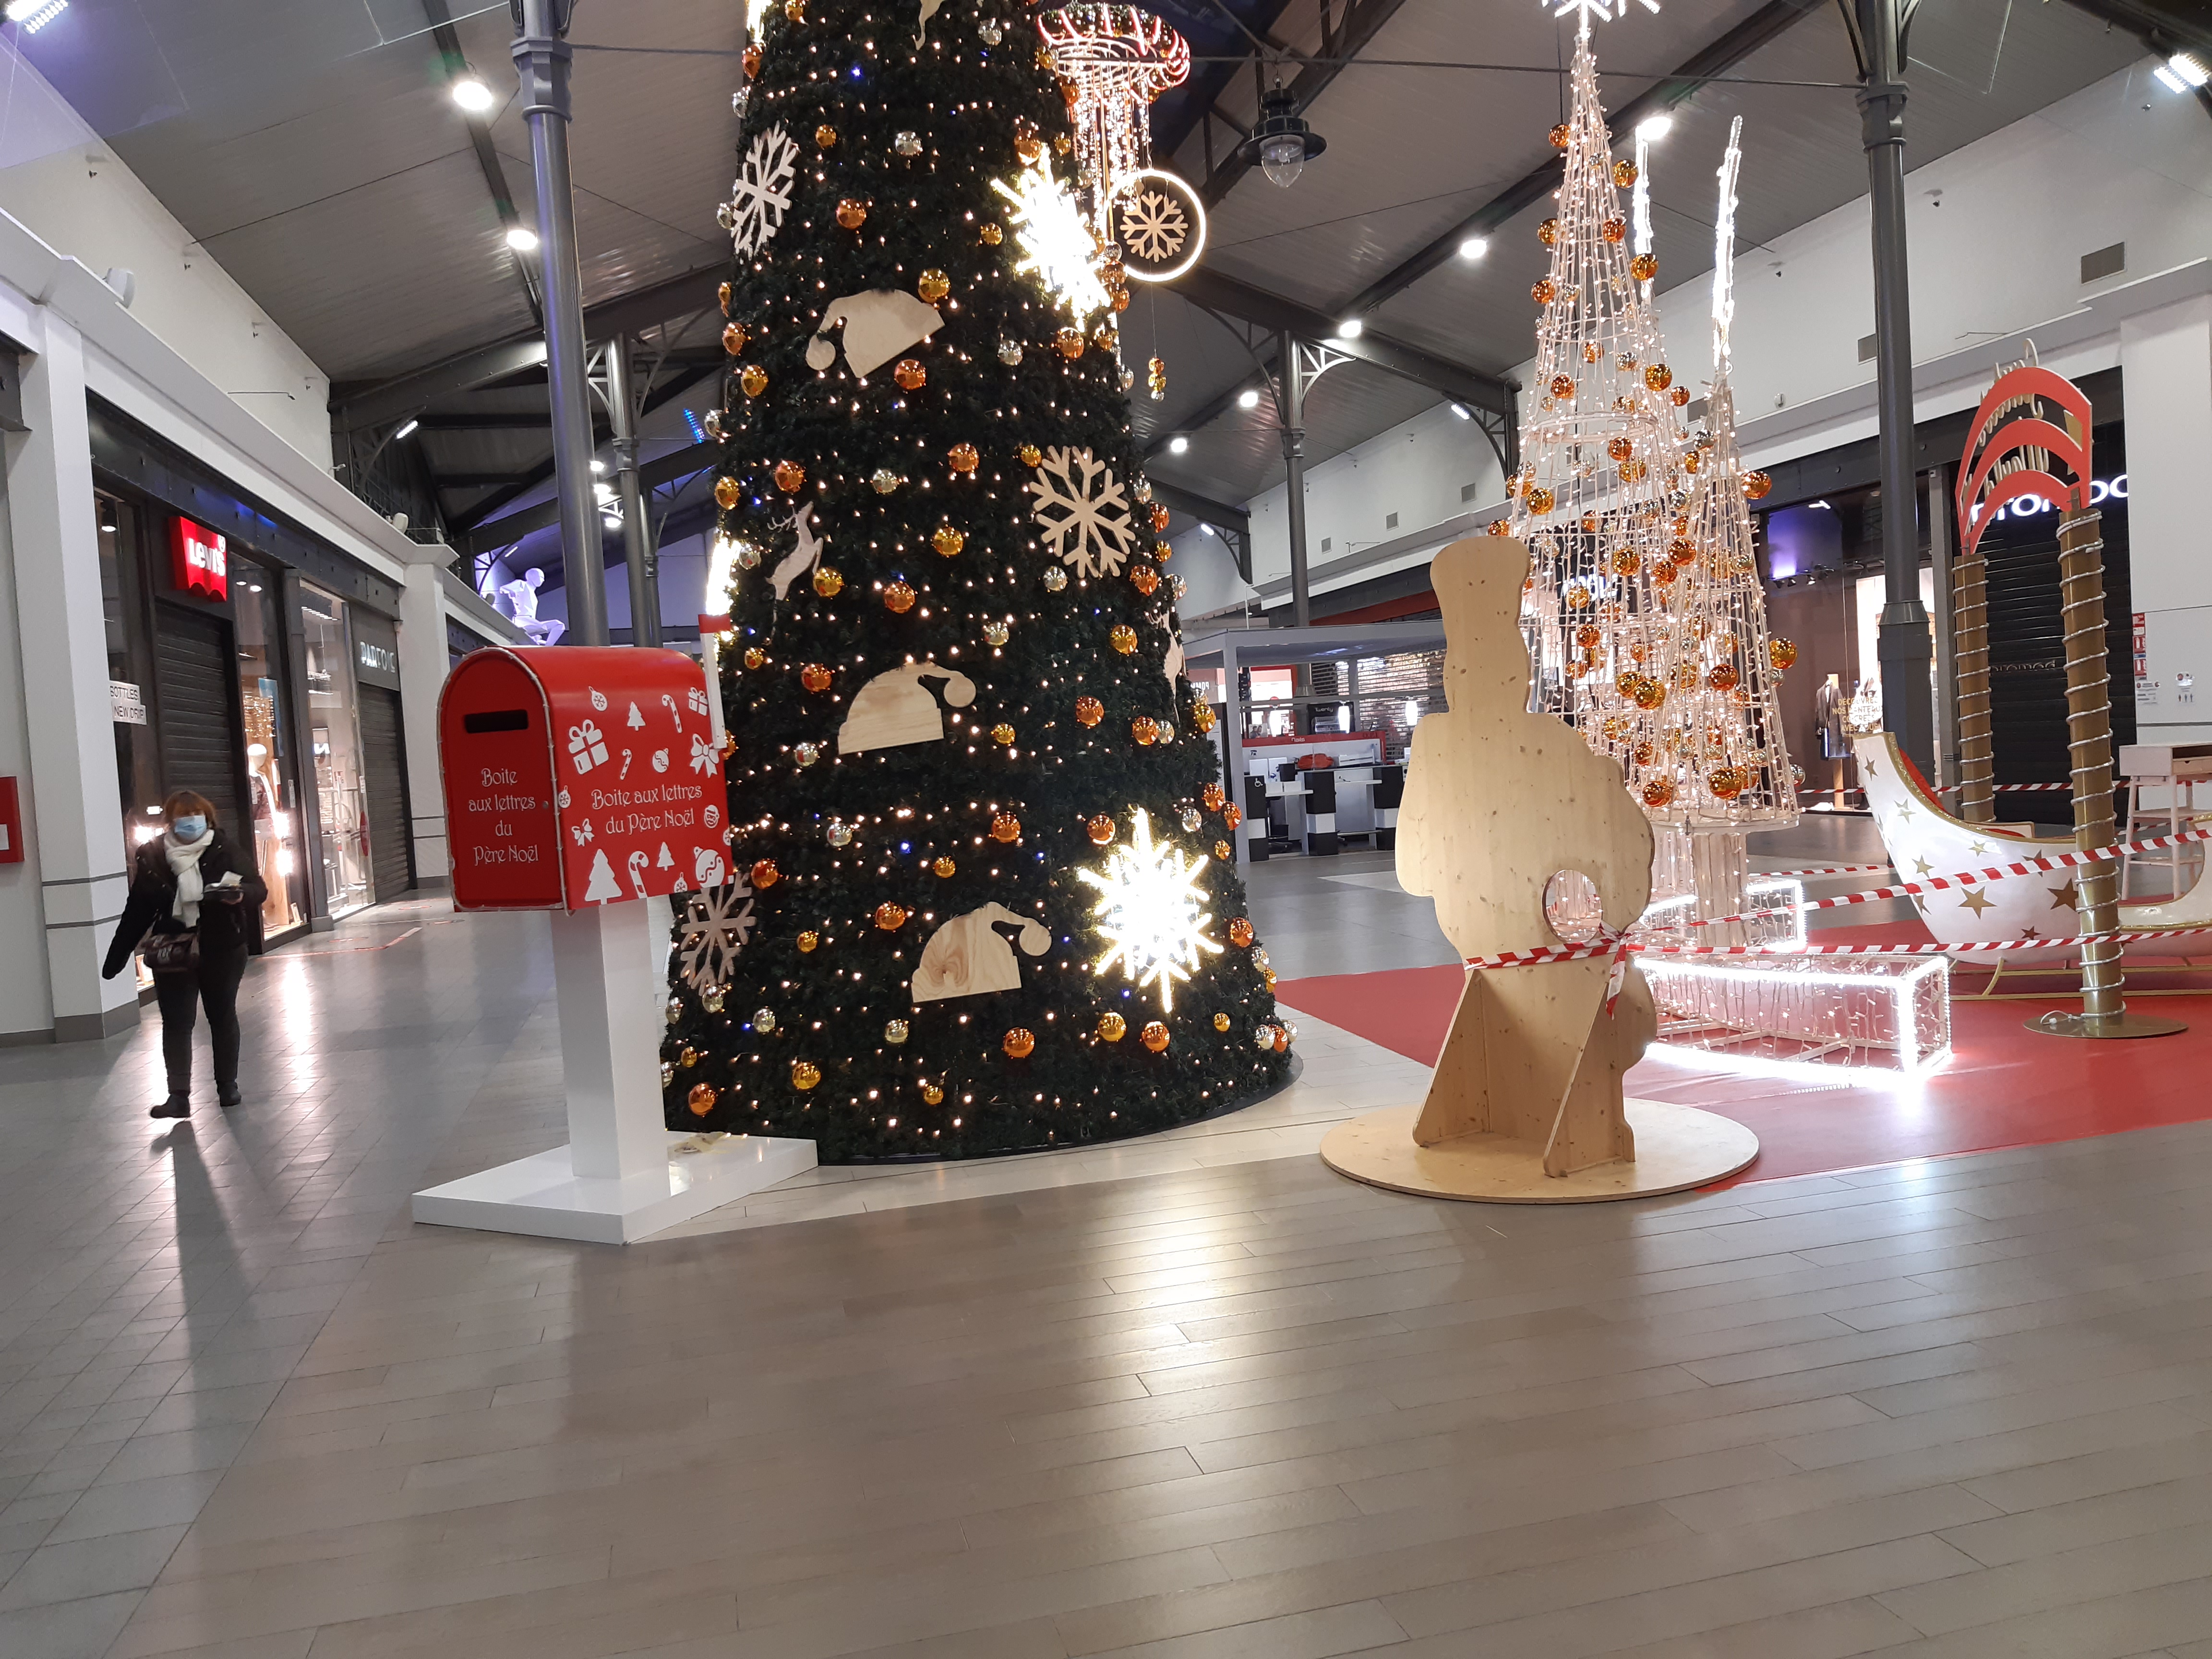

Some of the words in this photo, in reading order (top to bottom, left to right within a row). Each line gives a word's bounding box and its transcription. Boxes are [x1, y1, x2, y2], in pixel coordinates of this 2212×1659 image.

[115, 706, 129, 717] NEW
[1832, 707, 1846, 715] NOS
[481, 768, 517, 787] Boite
[469, 797, 493, 812] aux
[494, 793, 536, 812] lettres
[591, 789, 632, 810] Boite
[634, 788, 659, 804] aux
[661, 784, 702, 802] lettres
[495, 819, 513, 836] du
[606, 816, 625, 834] du
[627, 813, 661, 835] Père
[664, 807, 695, 828] Noël
[473, 845, 506, 866] Père
[508, 844, 539, 864] Noël
